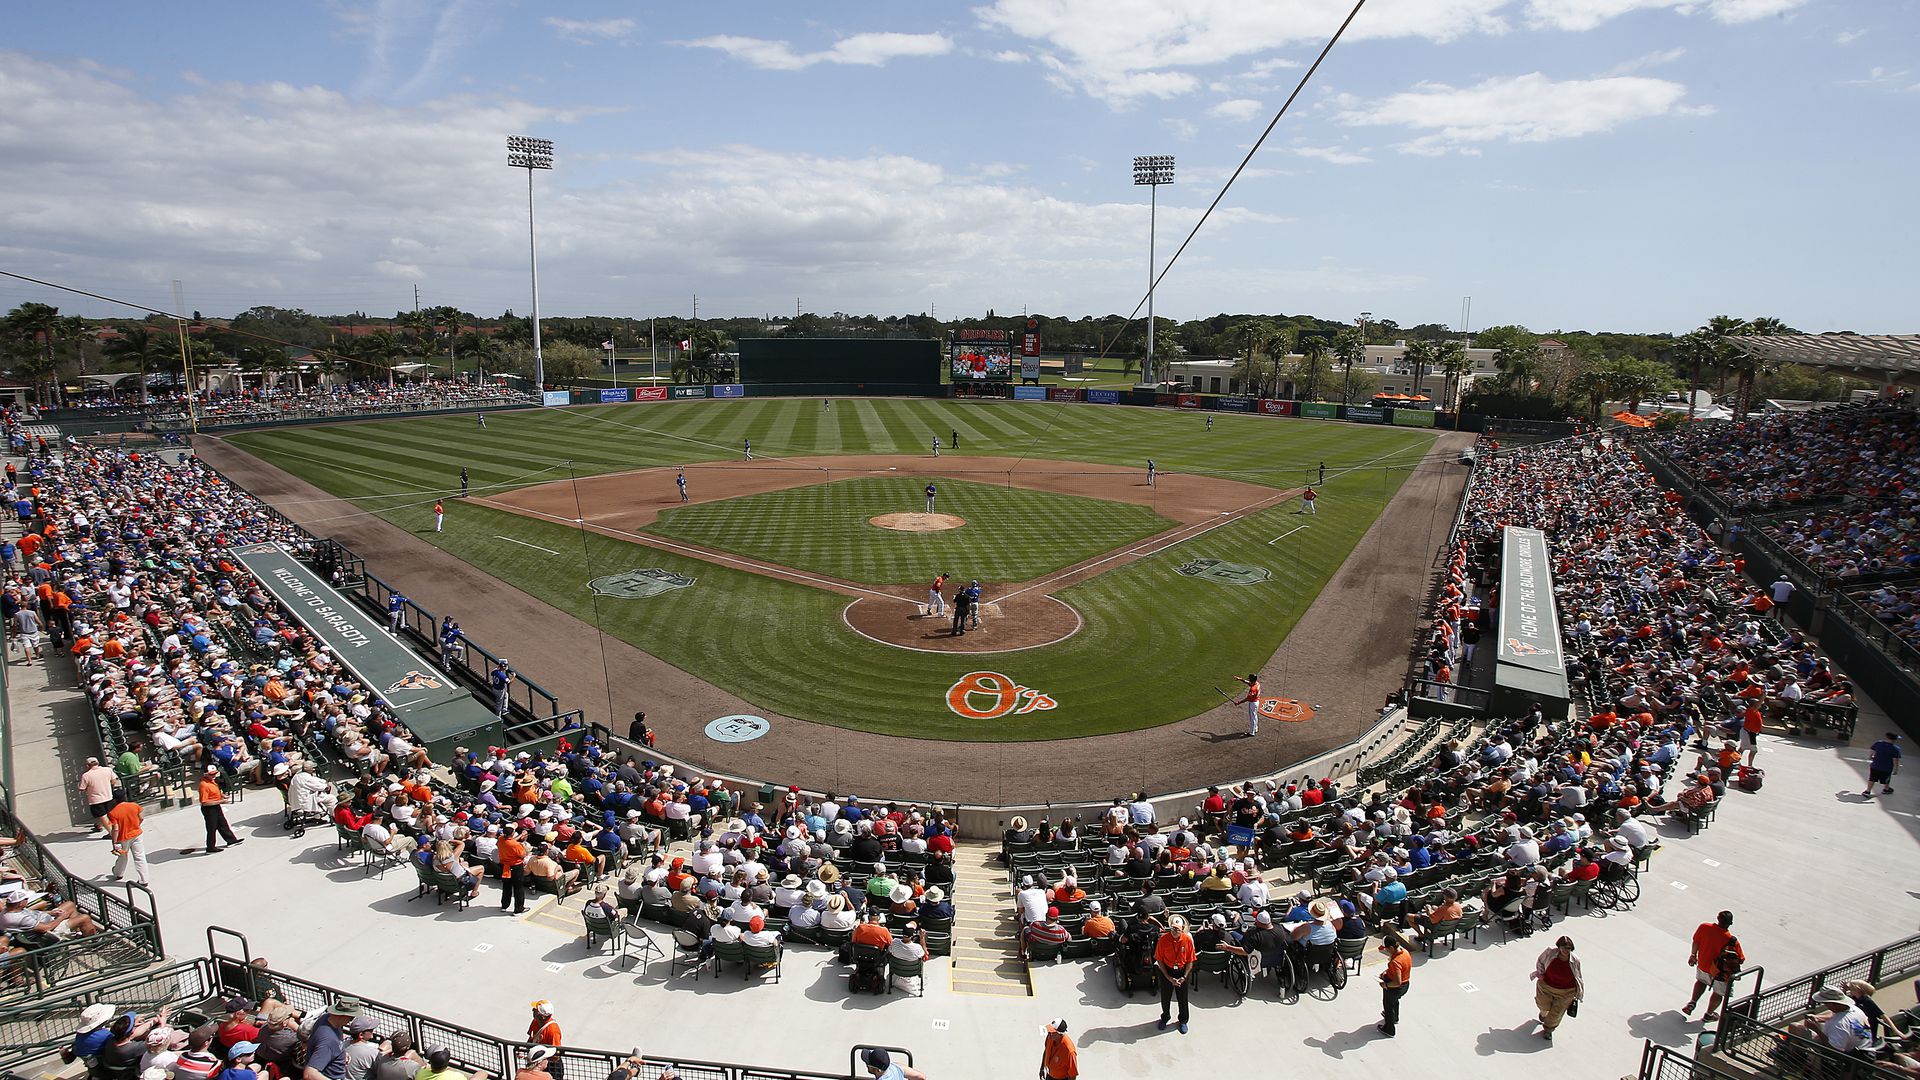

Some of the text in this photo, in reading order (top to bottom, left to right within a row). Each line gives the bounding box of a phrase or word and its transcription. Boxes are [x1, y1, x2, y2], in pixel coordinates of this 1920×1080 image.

[1265, 401, 1284, 410] Coors
[1519, 557, 1534, 588] BALTIMORE
[609, 578, 648, 592] FL
[1520, 587, 1535, 602] THE
[272, 568, 371, 648] WELCOME TO SARASOTA
[1521, 601, 1536, 613] OF
[1521, 613, 1538, 639] HOME
[946, 671, 1058, 719] O's
[725, 724, 742, 734] FL
